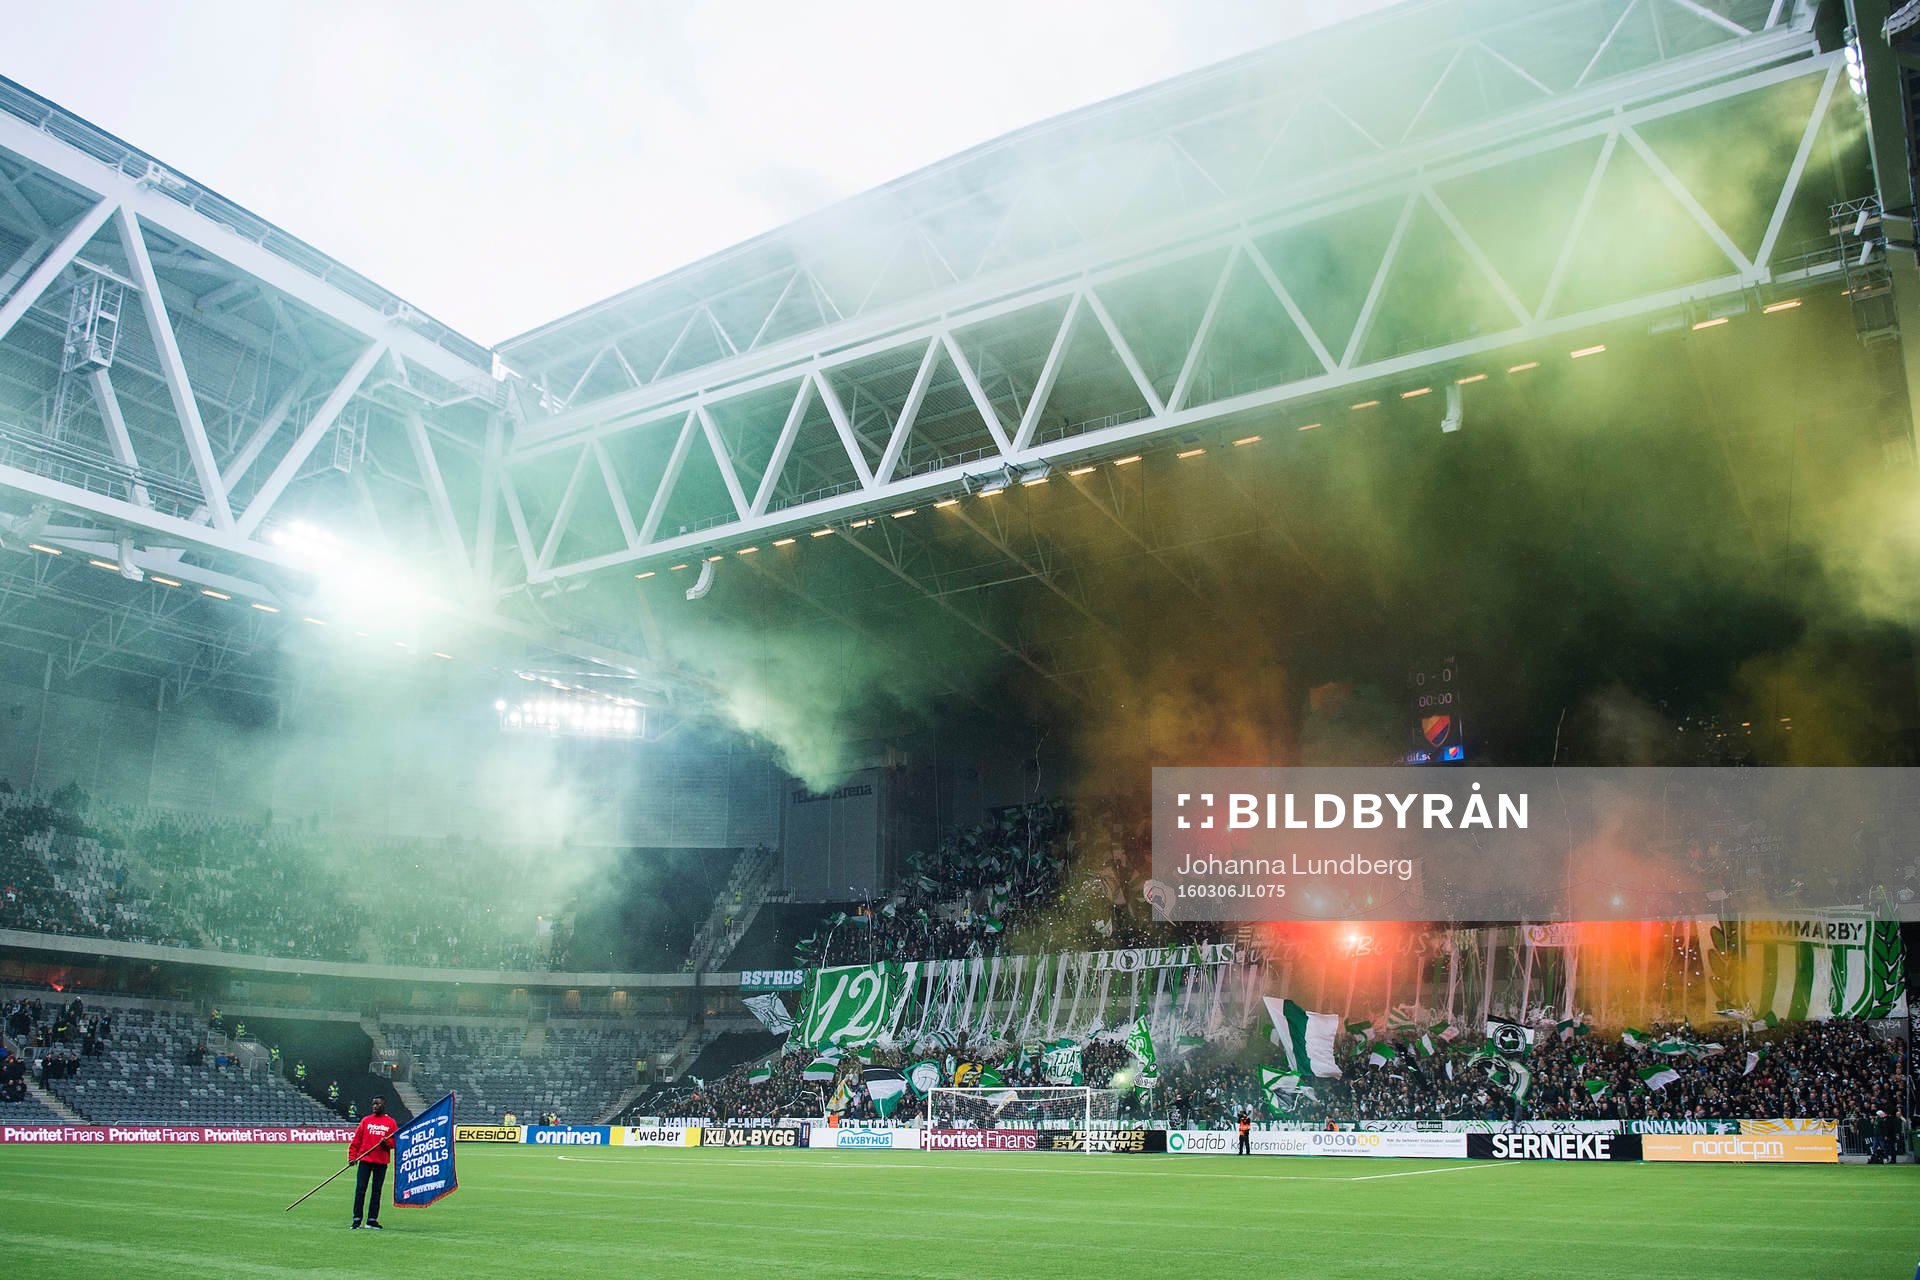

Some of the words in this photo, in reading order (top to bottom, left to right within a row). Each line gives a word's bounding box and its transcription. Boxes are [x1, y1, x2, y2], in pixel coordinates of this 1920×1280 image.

[1419, 693, 1452, 707] 00:00
[1750, 918, 1863, 940] HAMMARBY
[741, 970, 803, 985] BSTRDS
[811, 968, 882, 1045] 12
[4, 1127, 63, 1142] Prioritet
[64, 1128, 105, 1142] Finans
[109, 1128, 162, 1142] Prioritet
[163, 1129, 200, 1142] Finans
[459, 1126, 517, 1140] EKESIÖÖ
[1631, 1119, 1707, 1134] CINNAMON
[204, 1129, 252, 1142] Prioritet
[253, 1130, 287, 1142] Finans
[290, 1130, 335, 1142] Prioritet
[336, 1130, 355, 1142] Fina
[412, 1128, 435, 1145] HELA
[535, 1127, 601, 1145] onninen
[638, 1128, 680, 1143] weber
[727, 1129, 795, 1146] XL-BYGG
[921, 1130, 983, 1148] Prioritet
[987, 1131, 1036, 1148] Finans
[1072, 1131, 1146, 1141] TAILOR
[1187, 1133, 1225, 1150] bafab
[402, 1137, 446, 1161] SVERIGES
[1052, 1140, 1144, 1150] EVENTS
[1492, 1134, 1611, 1159] SERNEKE
[1693, 1136, 1784, 1160] nordicpm
[400, 1149, 449, 1173] FOTBOLLS
[408, 1164, 440, 1183] KLUBB
